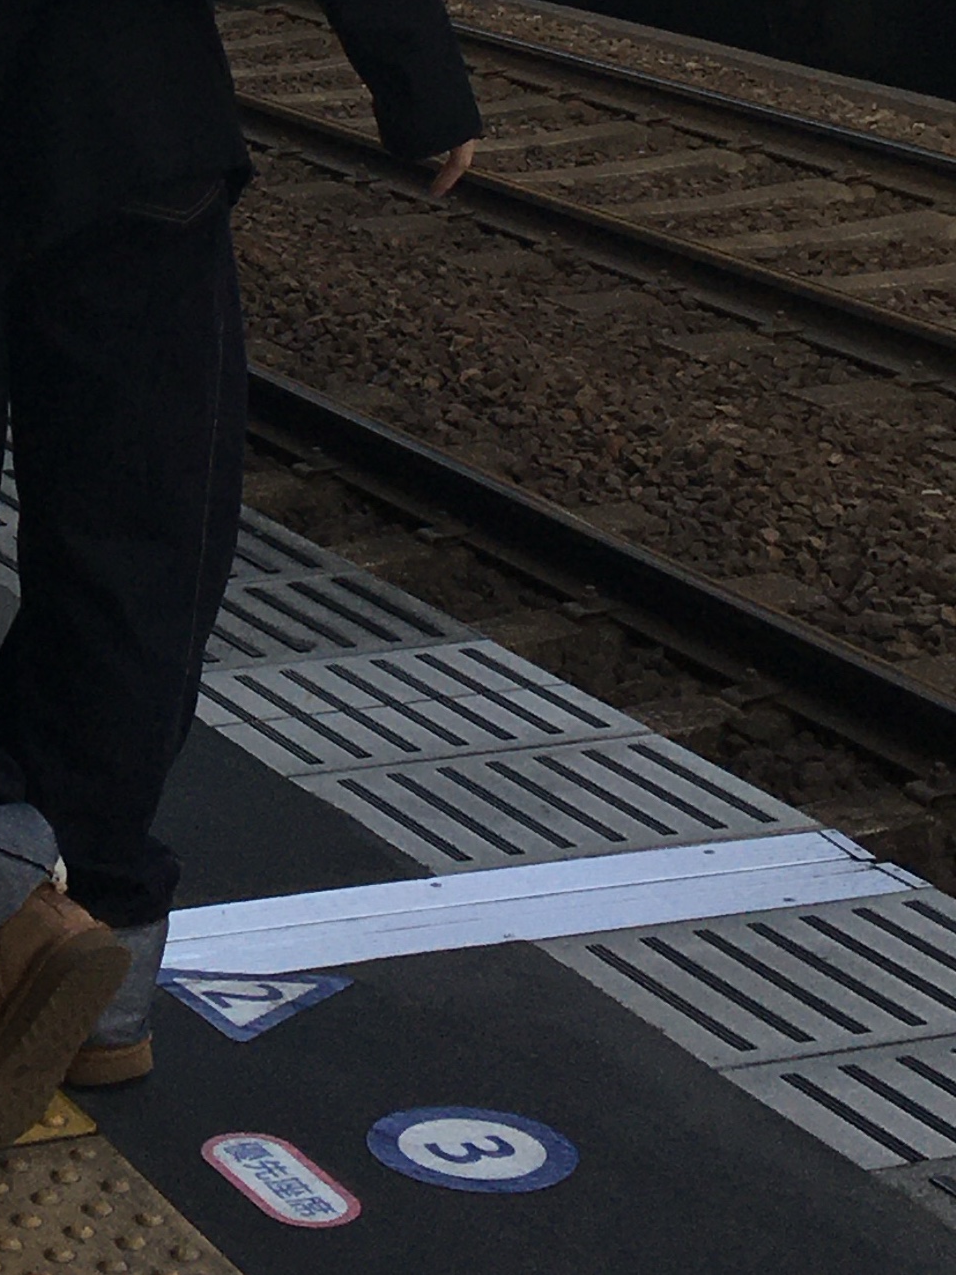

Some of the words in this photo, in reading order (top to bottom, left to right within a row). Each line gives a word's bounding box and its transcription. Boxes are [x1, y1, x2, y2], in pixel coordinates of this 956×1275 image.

[200, 983, 284, 1009] 2
[424, 1134, 517, 1165] 3
[222, 1139, 337, 1218] 優先座席
